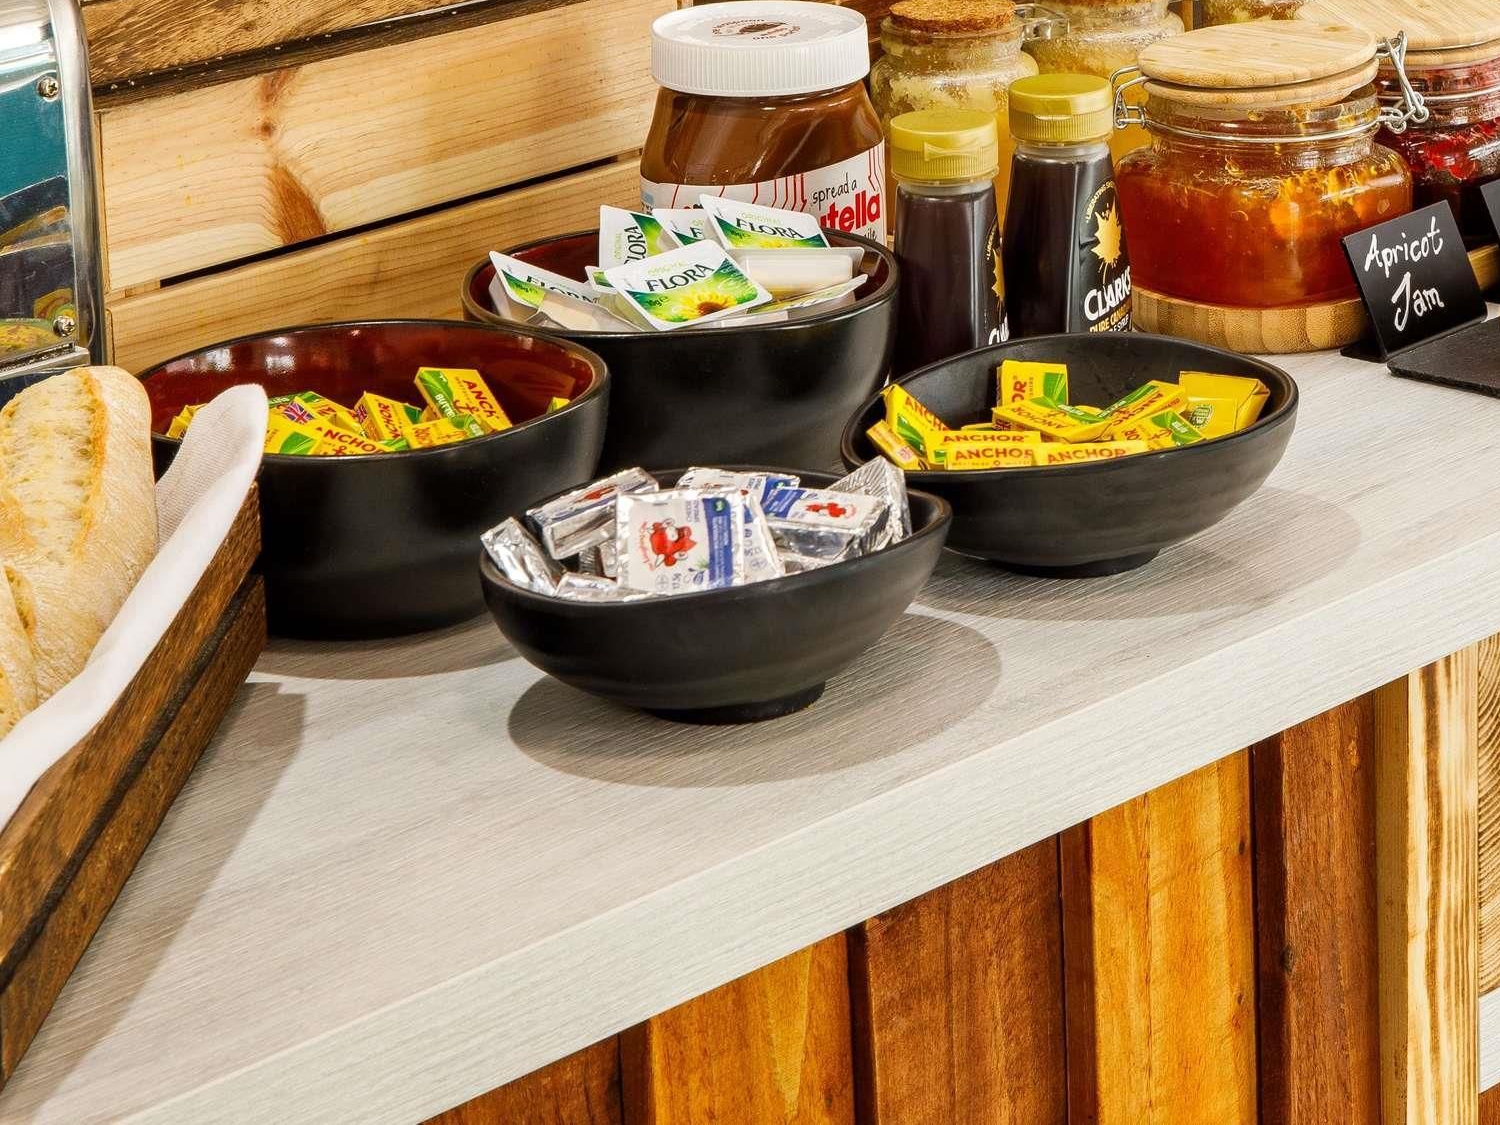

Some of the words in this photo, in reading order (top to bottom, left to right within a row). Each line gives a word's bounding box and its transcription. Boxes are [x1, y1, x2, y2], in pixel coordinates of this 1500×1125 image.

[812, 172, 849, 211] spread
[850, 179, 858, 190] a
[736, 218, 804, 238] FLORA
[820, 190, 881, 232] tella
[624, 225, 647, 265] LORA
[1364, 216, 1444, 278] Apricot
[645, 263, 716, 292] FLORA
[1391, 272, 1445, 332] Jam
[434, 393, 456, 418] BUTTE
[462, 379, 500, 420] ANCH
[904, 396, 950, 431] ANCH
[316, 427, 385, 454] NCHO
[943, 434, 1025, 442] ANCHOR
